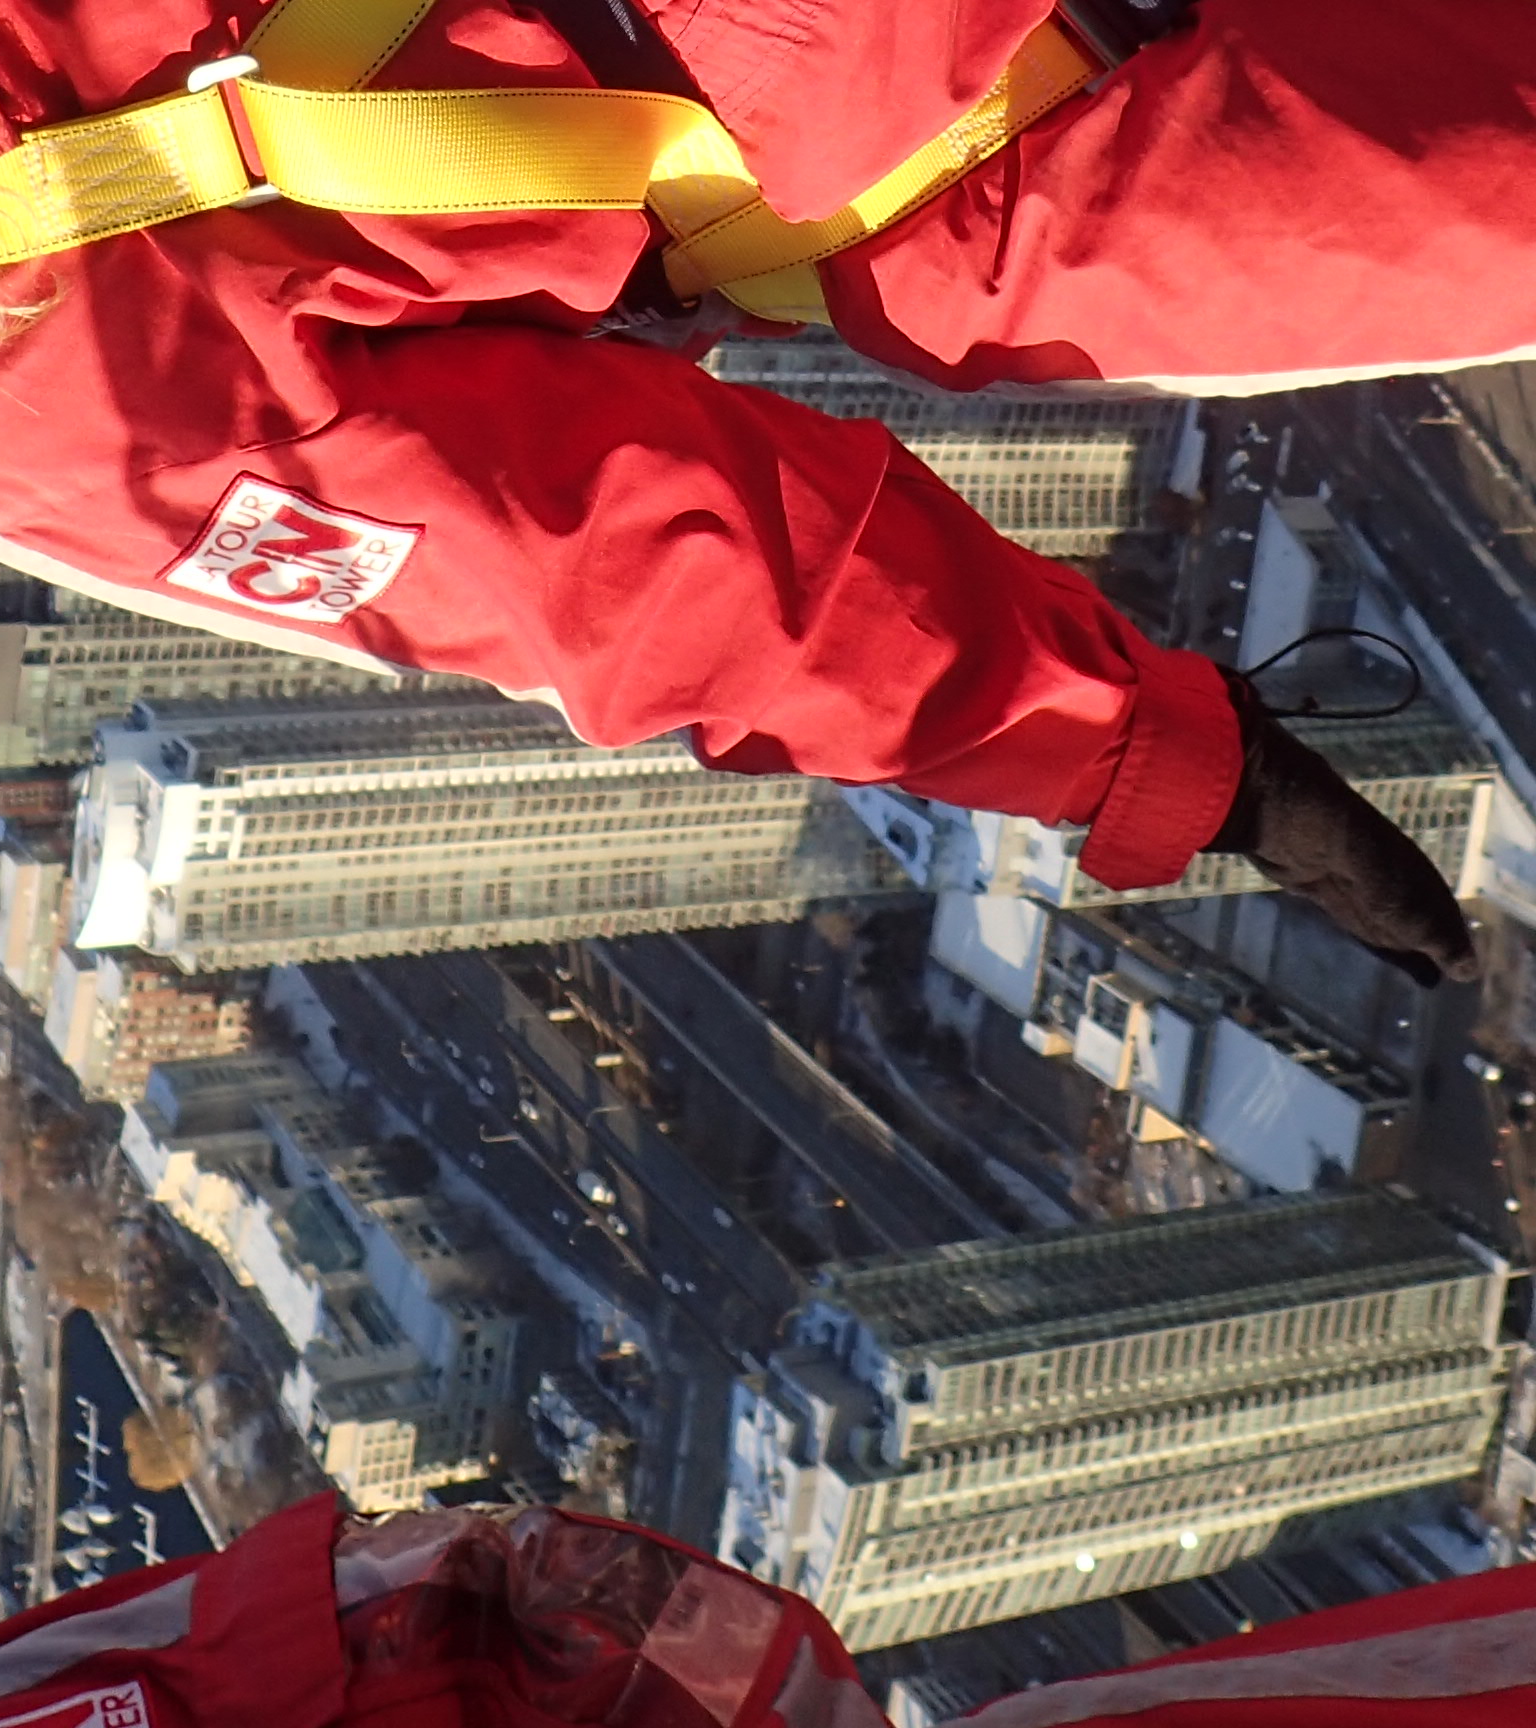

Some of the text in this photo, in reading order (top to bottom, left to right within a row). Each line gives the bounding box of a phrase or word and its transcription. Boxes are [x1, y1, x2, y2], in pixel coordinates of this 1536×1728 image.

[203, 495, 273, 561] TOUR
[226, 504, 360, 605] CN
[306, 539, 401, 613] TOWER
